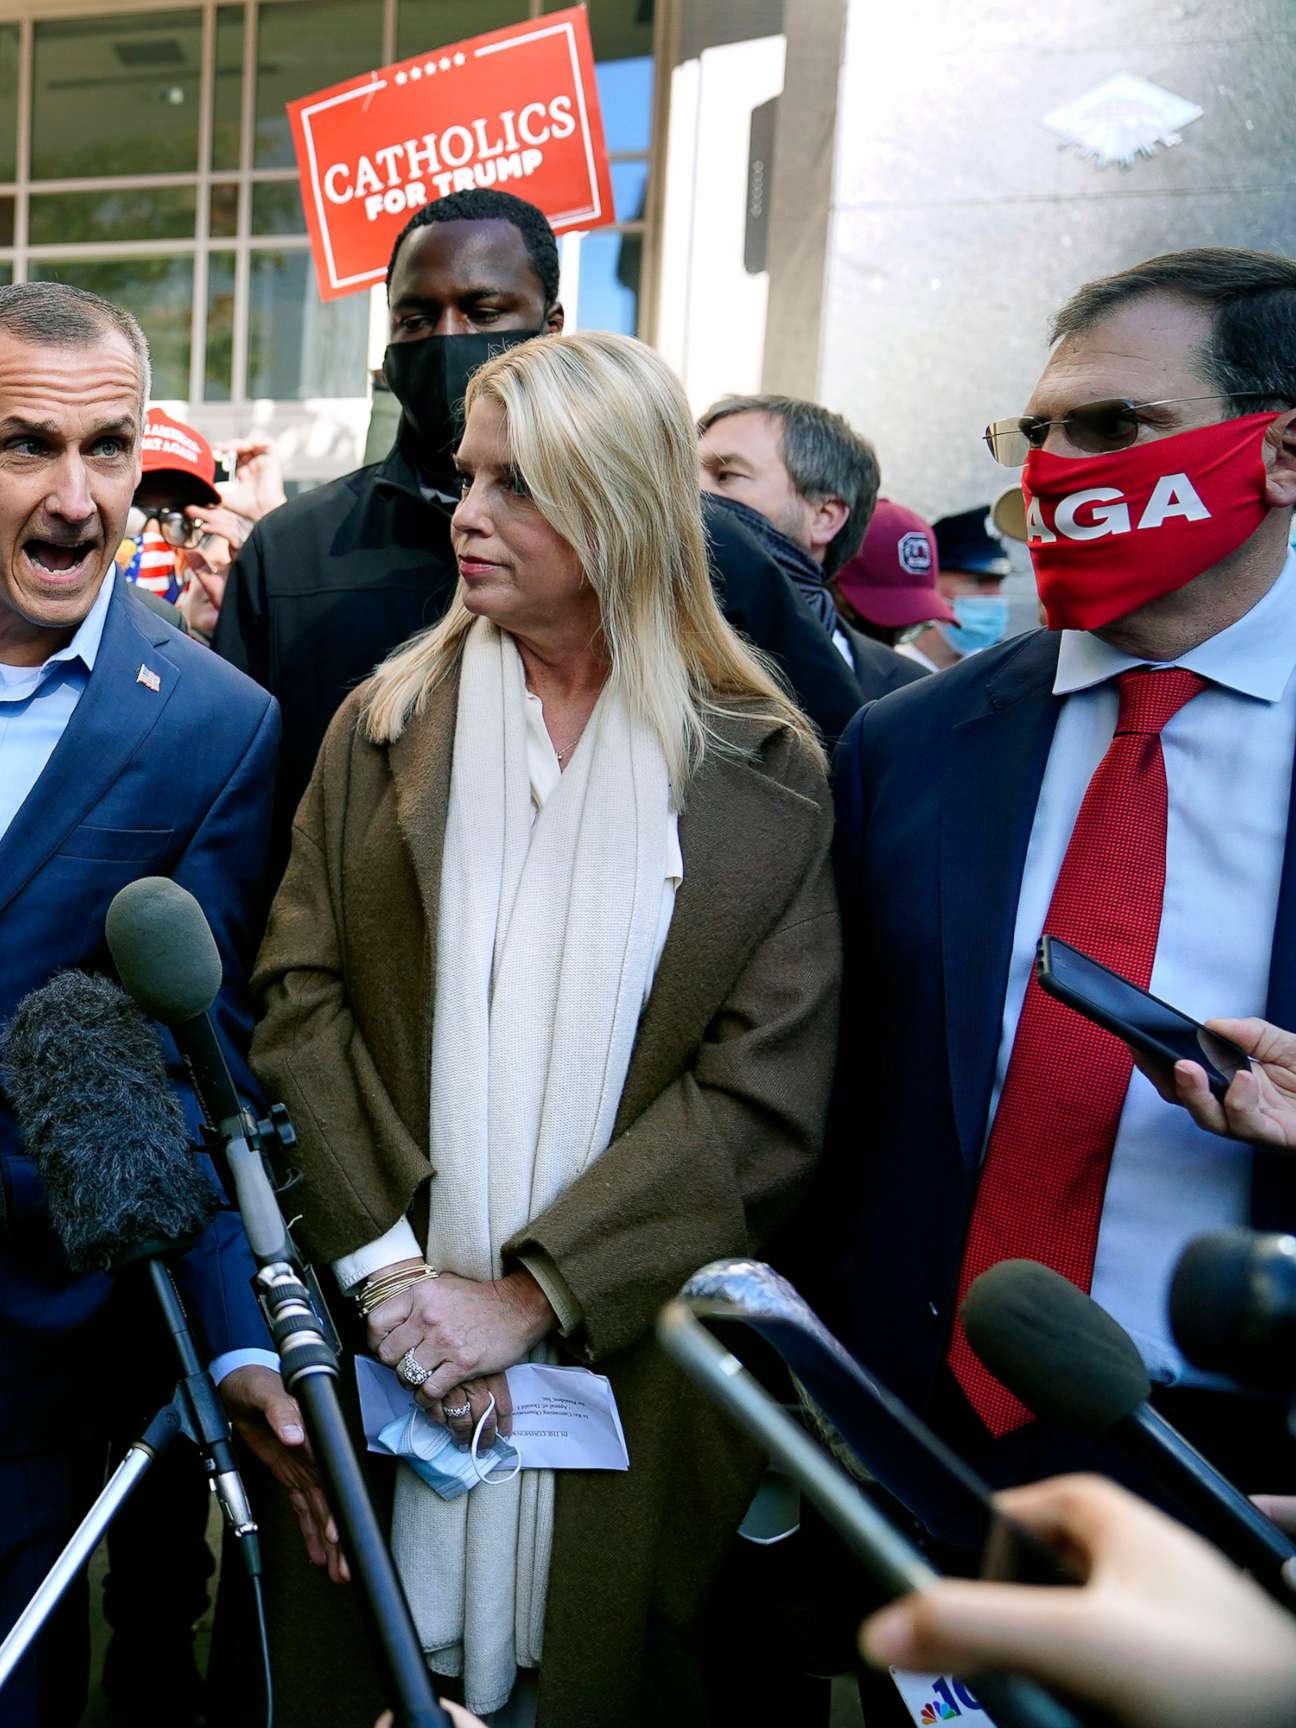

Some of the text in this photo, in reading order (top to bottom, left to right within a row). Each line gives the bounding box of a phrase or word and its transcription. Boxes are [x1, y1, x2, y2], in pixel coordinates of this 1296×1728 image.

[324, 95, 577, 204] CATHOLICS
[365, 148, 543, 222] FOR TRUMP
[1025, 472, 1212, 544] AGA
